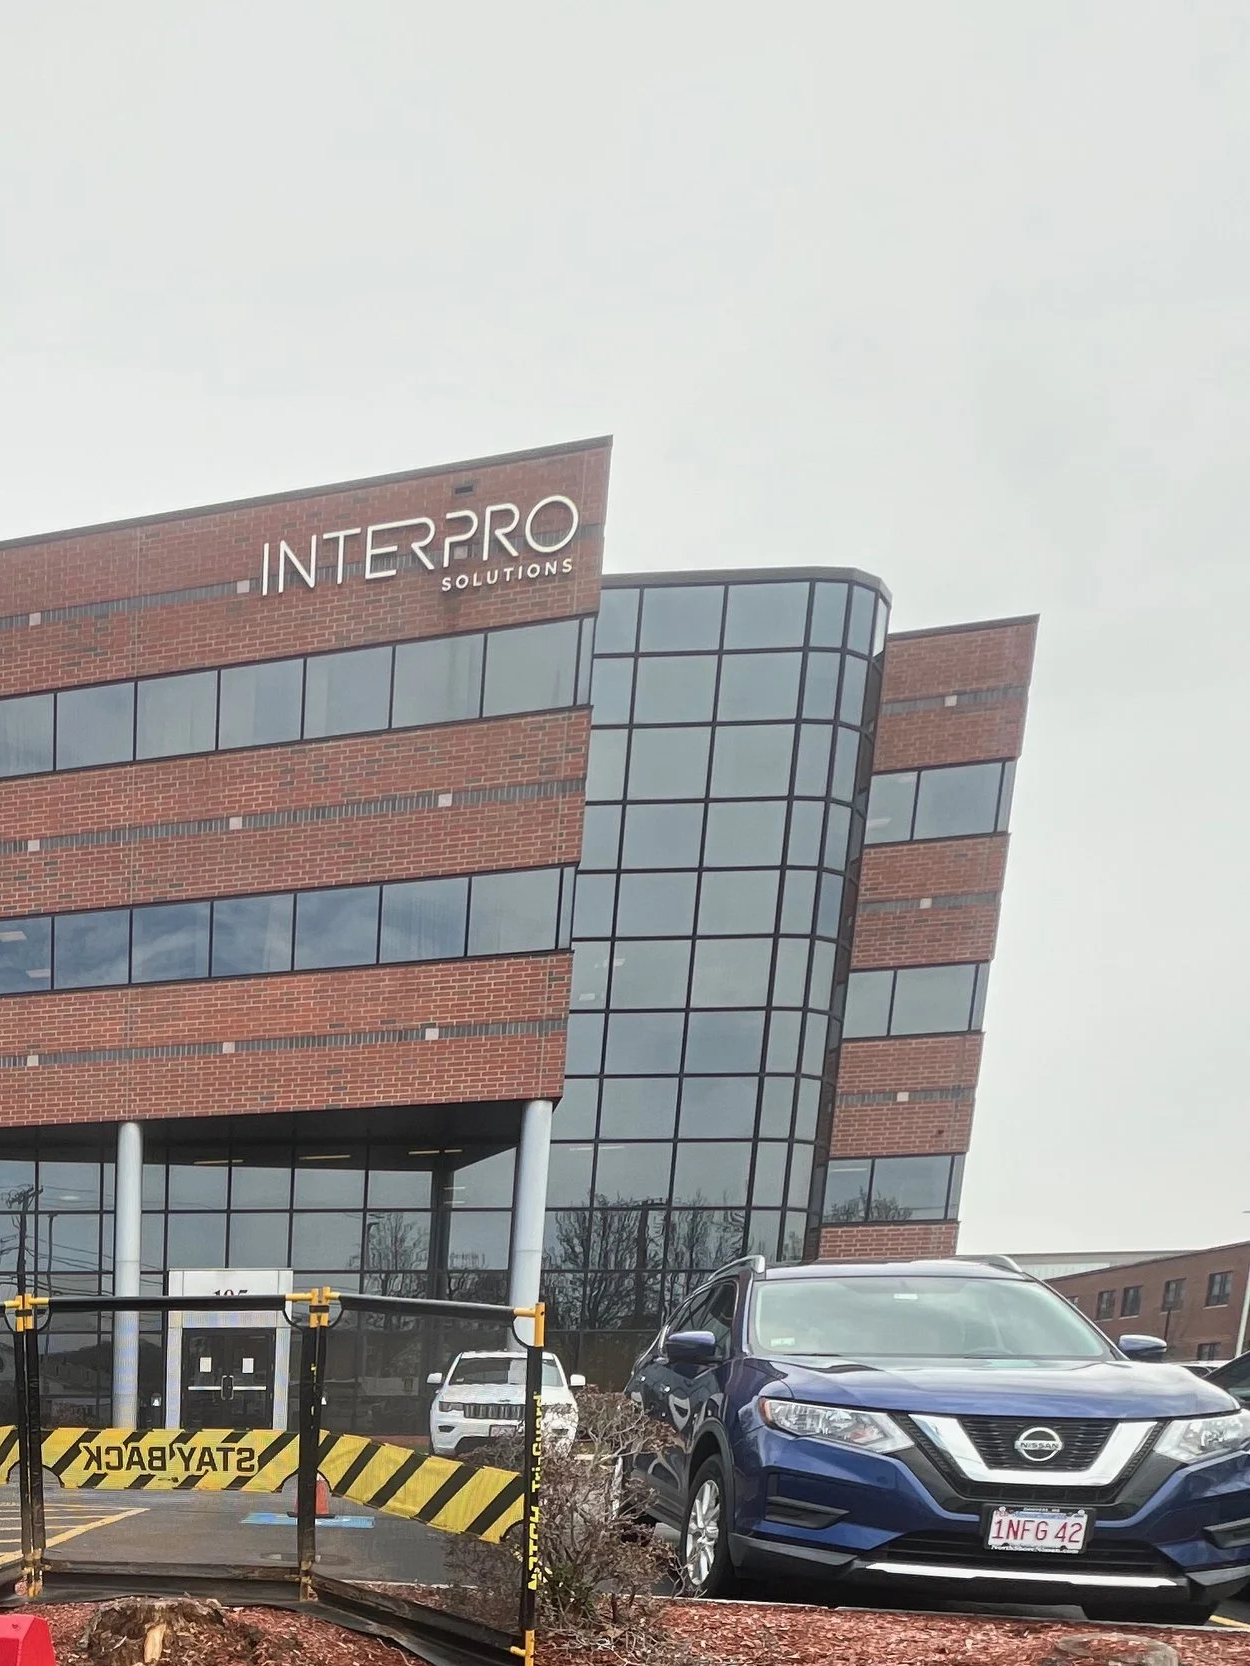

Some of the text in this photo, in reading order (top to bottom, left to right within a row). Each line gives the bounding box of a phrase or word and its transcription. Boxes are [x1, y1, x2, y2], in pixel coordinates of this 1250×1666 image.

[261, 495, 580, 597] INTERPRO
[441, 557, 574, 593] SOLUTIONS
[991, 1519, 1083, 1543] 1NFG 42
